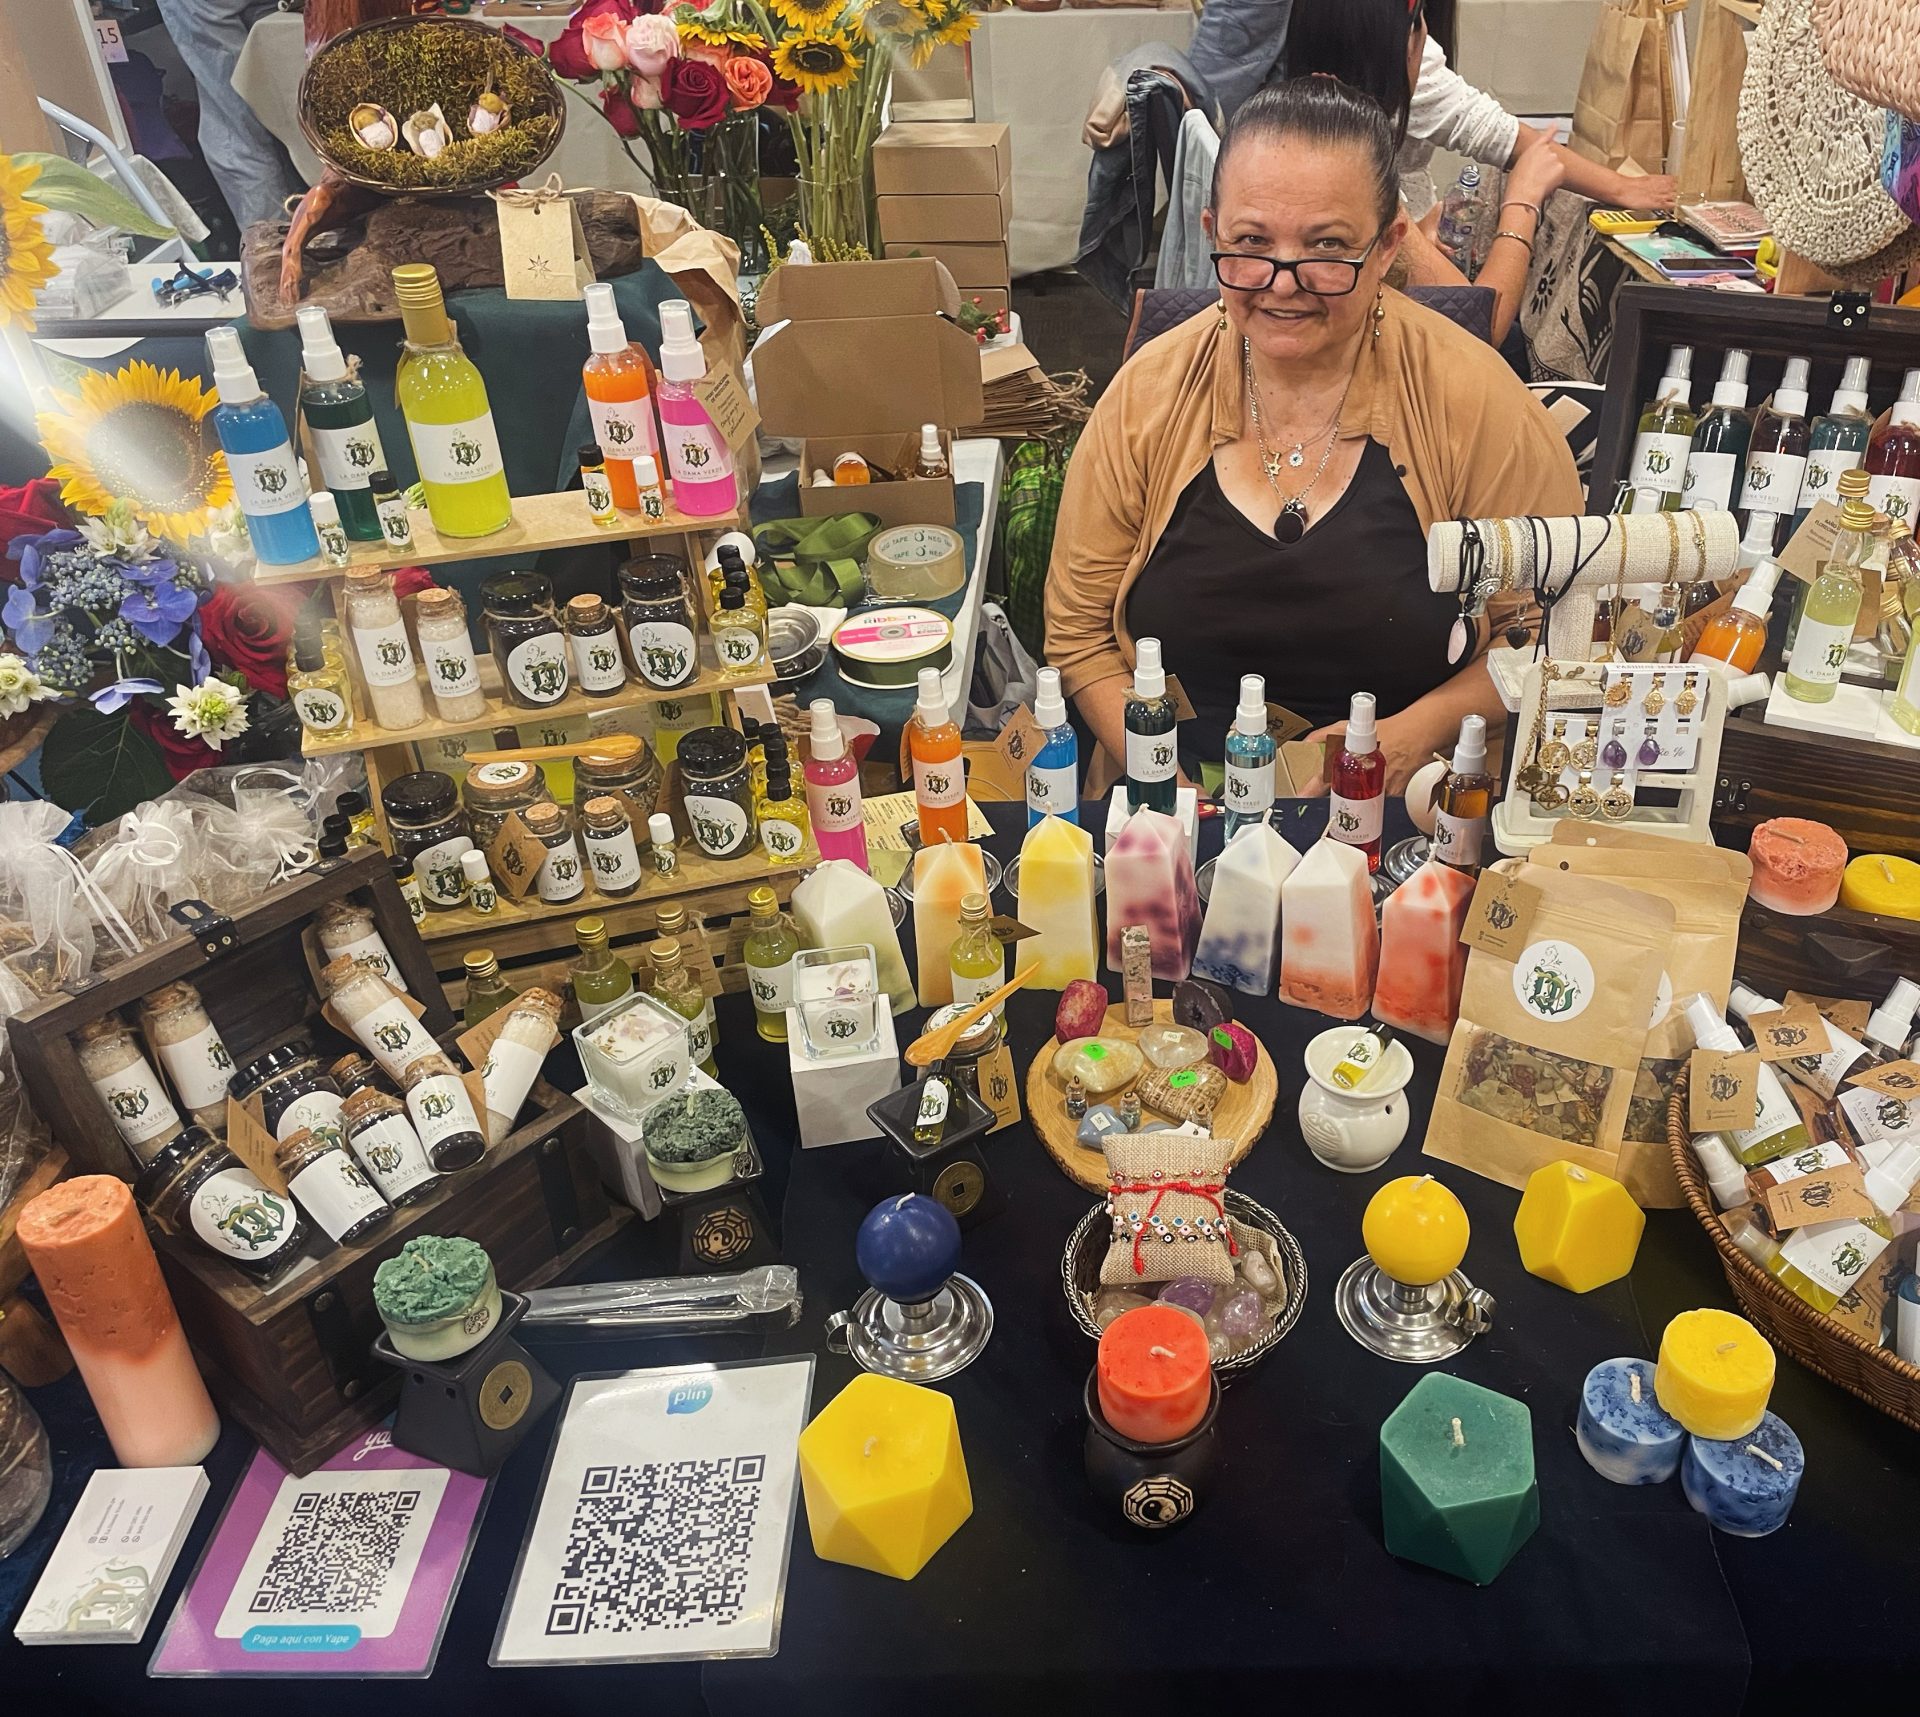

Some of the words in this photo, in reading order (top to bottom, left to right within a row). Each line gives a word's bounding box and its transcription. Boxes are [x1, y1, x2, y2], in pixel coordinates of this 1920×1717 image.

[97, 27, 119, 45] 15
[703, 466, 723, 476] VERDE
[892, 535, 909, 545] TAPE
[894, 550, 910, 559] TAPE
[1764, 1112, 1786, 1125] VERDE
[1818, 1268, 1839, 1283] DAMA
[673, 1388, 707, 1406] plin
[252, 1633, 278, 1646] Paga
[303, 1635, 323, 1644] con
[325, 1633, 350, 1646] Yape
